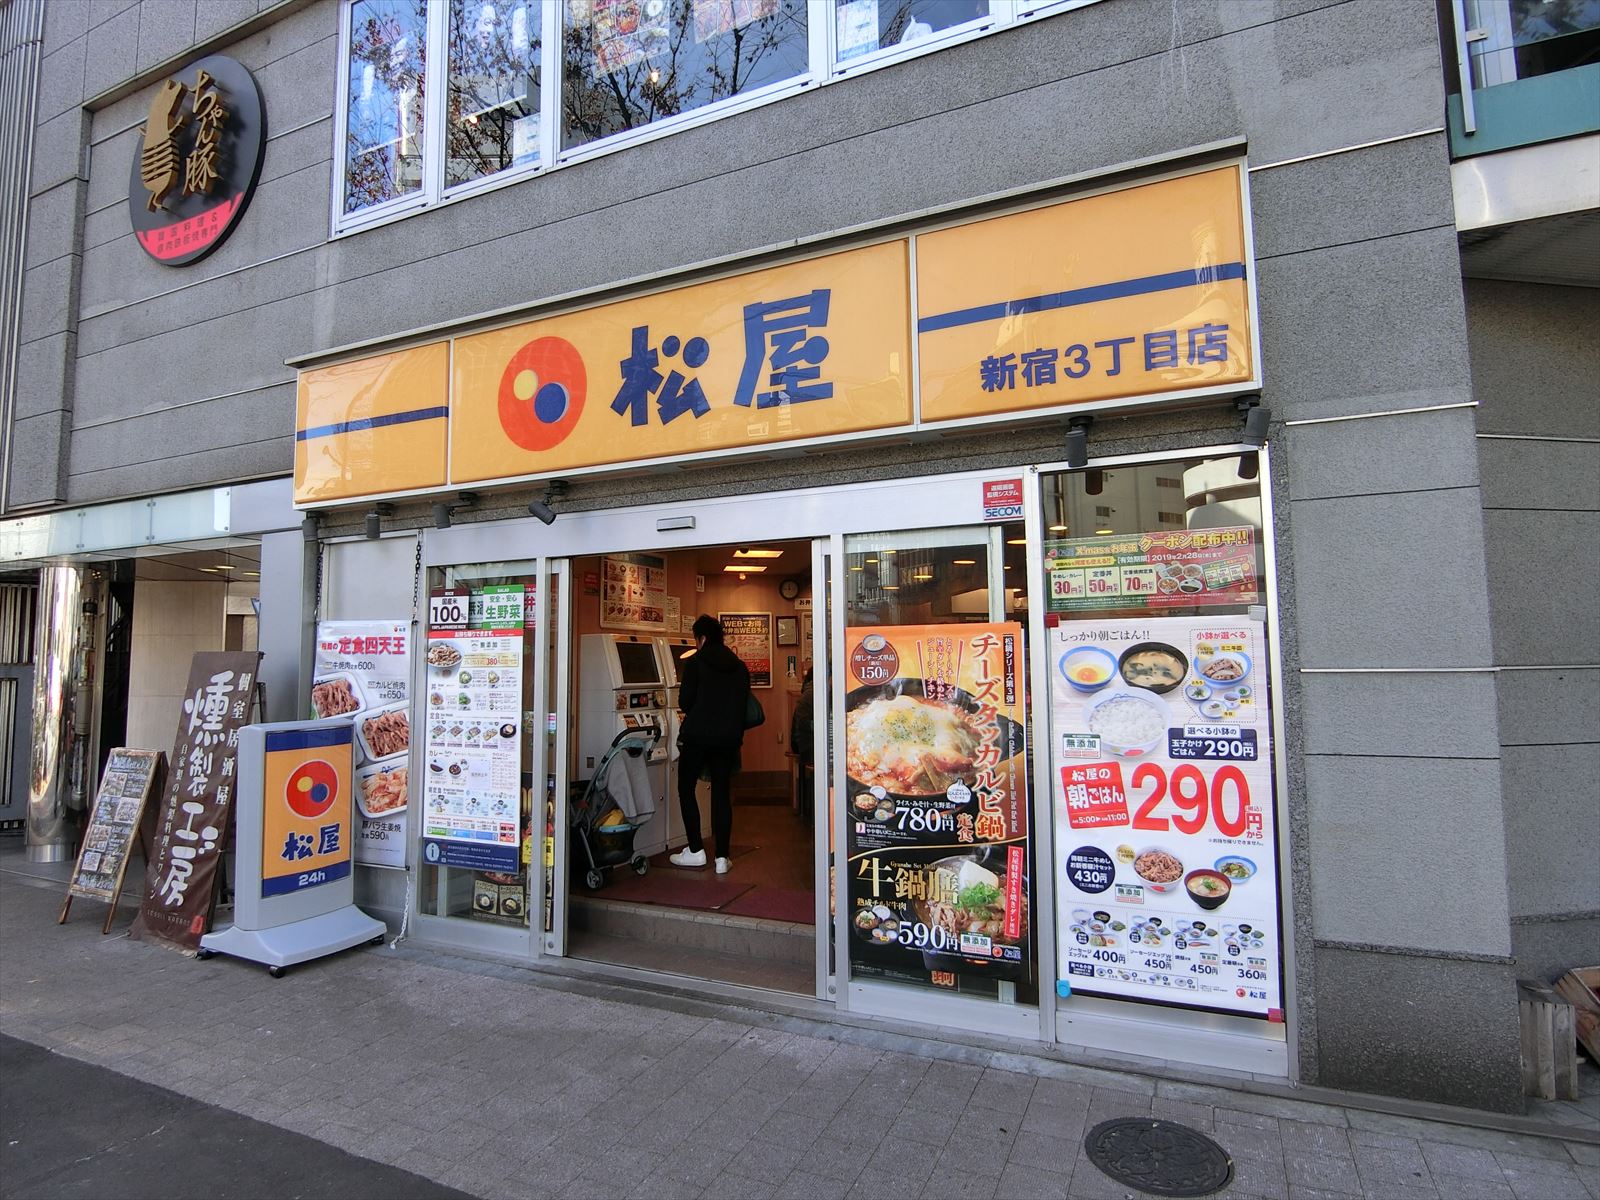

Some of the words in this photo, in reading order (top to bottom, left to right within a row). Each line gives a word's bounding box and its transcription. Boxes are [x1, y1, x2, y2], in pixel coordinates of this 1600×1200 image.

[610, 289, 834, 427] 松屋
[980, 324, 1230, 392] 新宿3丁目店
[985, 507, 1021, 517] SECOM
[1139, 530, 1248, 552] クーポン配布中!!
[485, 604, 521, 619] 生野菜
[1060, 630, 1150, 642] しっかり朝ごはん!!
[1196, 631, 1247, 640] 小鉢が選べる
[861, 666, 889, 679] 150円
[971, 634, 1007, 840] チーズタッカルビ鍋
[1187, 727, 1237, 736] 選べる小鉢の
[1066, 739, 1097, 748] 無添加
[1171, 739, 1203, 748] 玉子かけ
[1204, 740, 1254, 757] 290円
[1172, 748, 1196, 756] ごはん
[1071, 768, 1110, 781] 松屋の
[1067, 783, 1124, 810] 朝ごはん
[1131, 763, 1250, 837] 290
[895, 807, 954, 832] 780円
[957, 813, 974, 843] 定食
[1246, 831, 1263, 839] から
[281, 823, 341, 861] 松屋
[298, 871, 326, 887] 24h
[856, 857, 958, 904] 牛鍋膳
[1074, 870, 1108, 884] 430円
[898, 920, 958, 951] 590円
[962, 935, 988, 947] 無添加
[1093, 950, 1126, 965] 400円
[1144, 959, 1172, 971] 450円
[1190, 964, 1218, 976] 450円
[1238, 968, 1267, 981] 360円
[1249, 990, 1267, 999] 松屋
